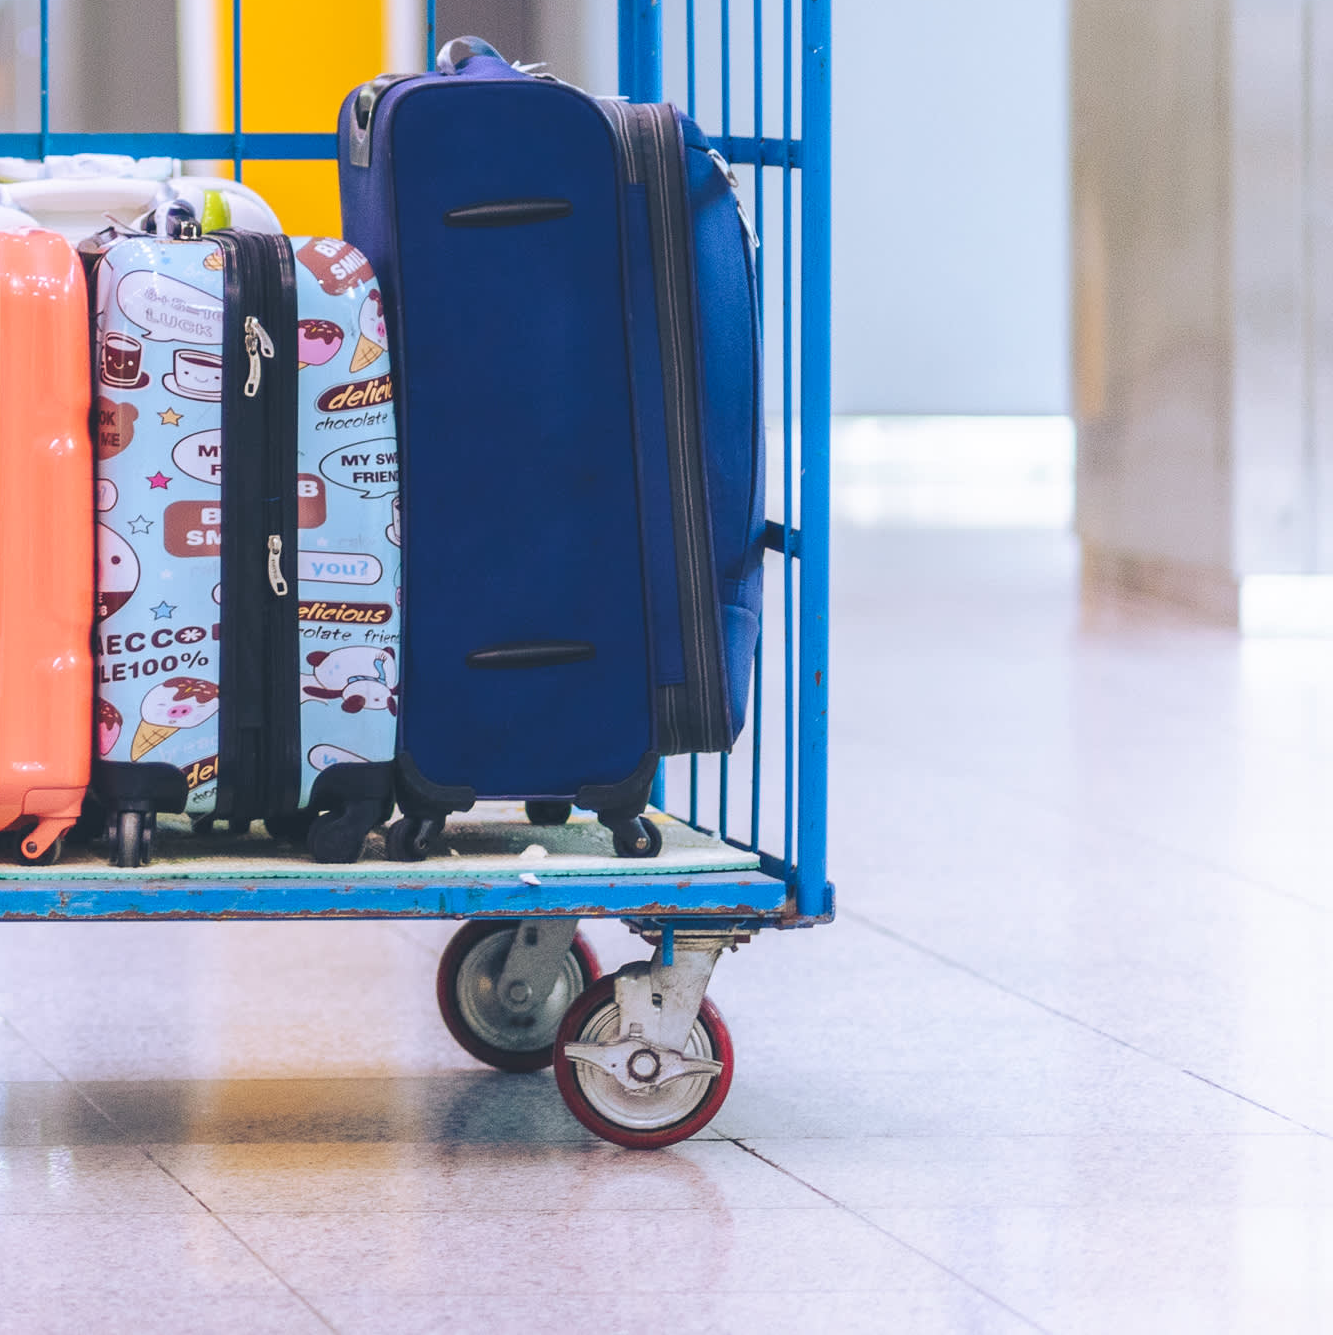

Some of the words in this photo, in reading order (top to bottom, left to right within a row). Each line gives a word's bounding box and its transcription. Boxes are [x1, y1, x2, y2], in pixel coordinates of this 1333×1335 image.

[145, 307, 213, 338] LUCK
[315, 411, 388, 431] chocolate
[198, 445, 221, 458] M
[341, 454, 371, 467] MY
[312, 561, 369, 577] you?
